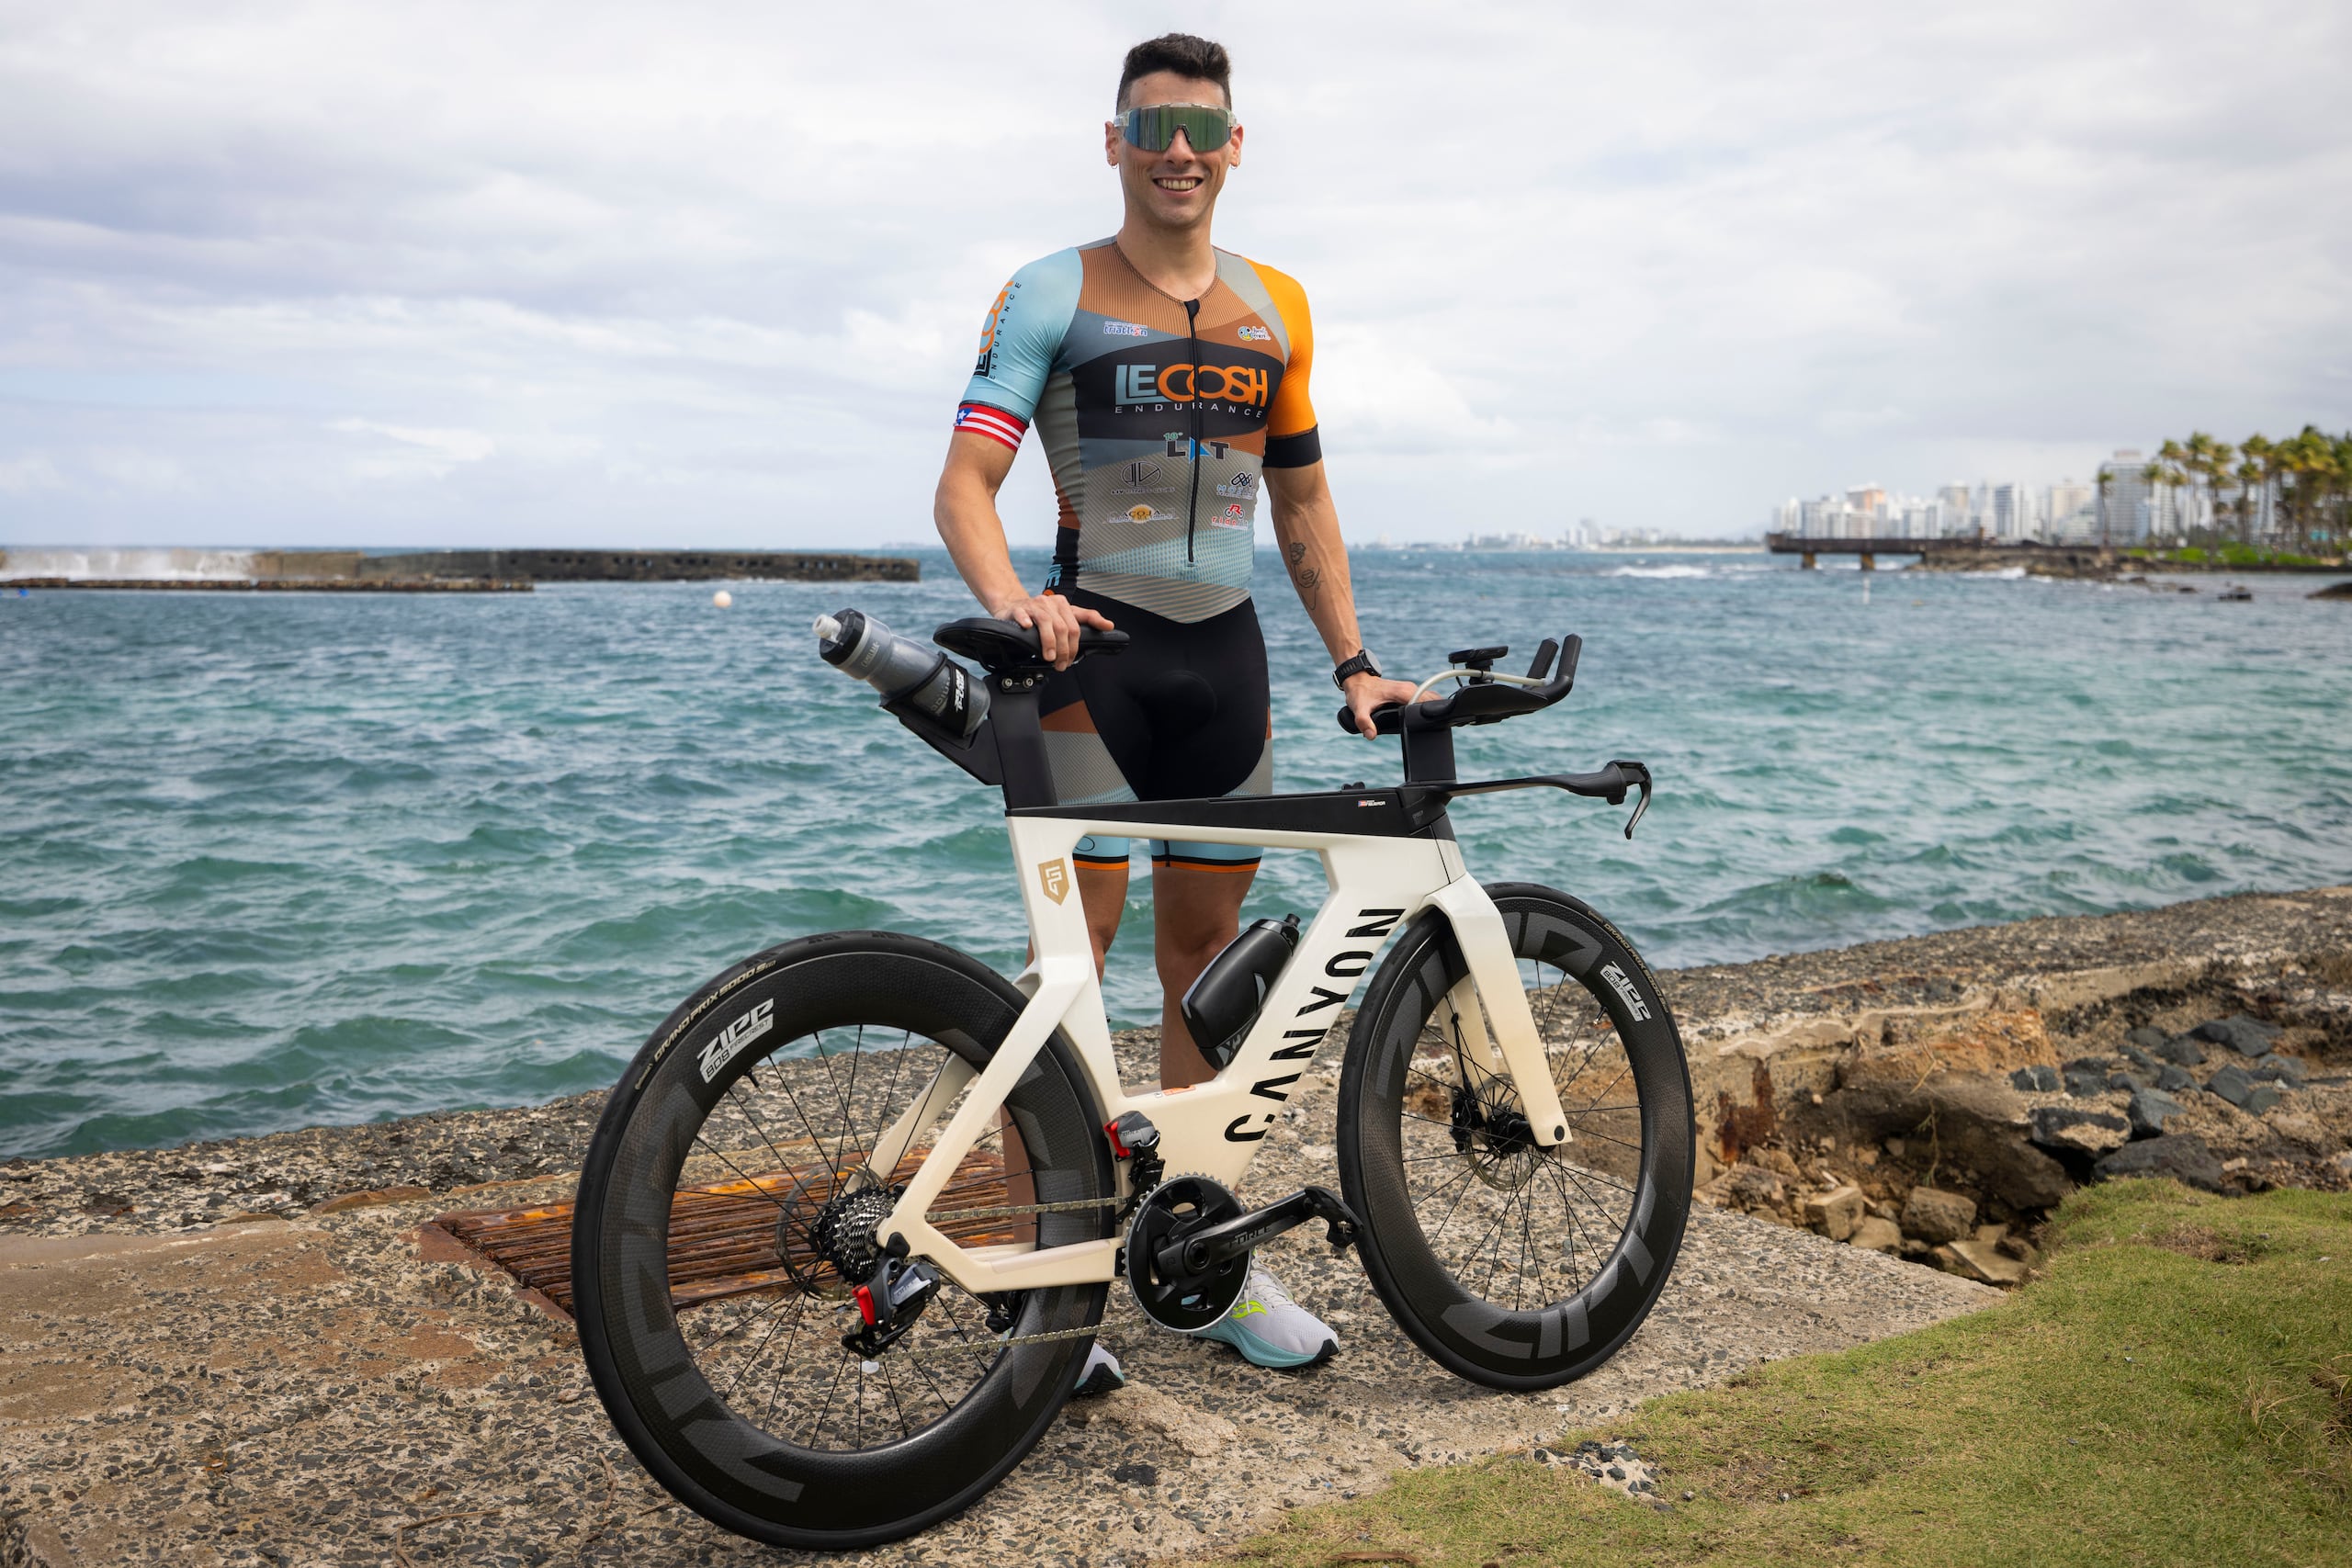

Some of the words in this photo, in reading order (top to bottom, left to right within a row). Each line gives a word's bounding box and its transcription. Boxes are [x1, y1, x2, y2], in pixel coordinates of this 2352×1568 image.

[989, 282, 1022, 380] ENDURANCE
[1115, 402, 1262, 419] ENDURANCE
[654, 1016, 690, 1062] GRAND
[690, 991, 718, 1021] PRIX
[719, 968, 755, 997] 5000
[1225, 908, 1406, 1143] CANYON
[1605, 961, 1652, 1020] ZIPP
[696, 998, 775, 1069] ZIPP
[706, 1051, 730, 1078] 808
[729, 1019, 770, 1052] FIRECREST
